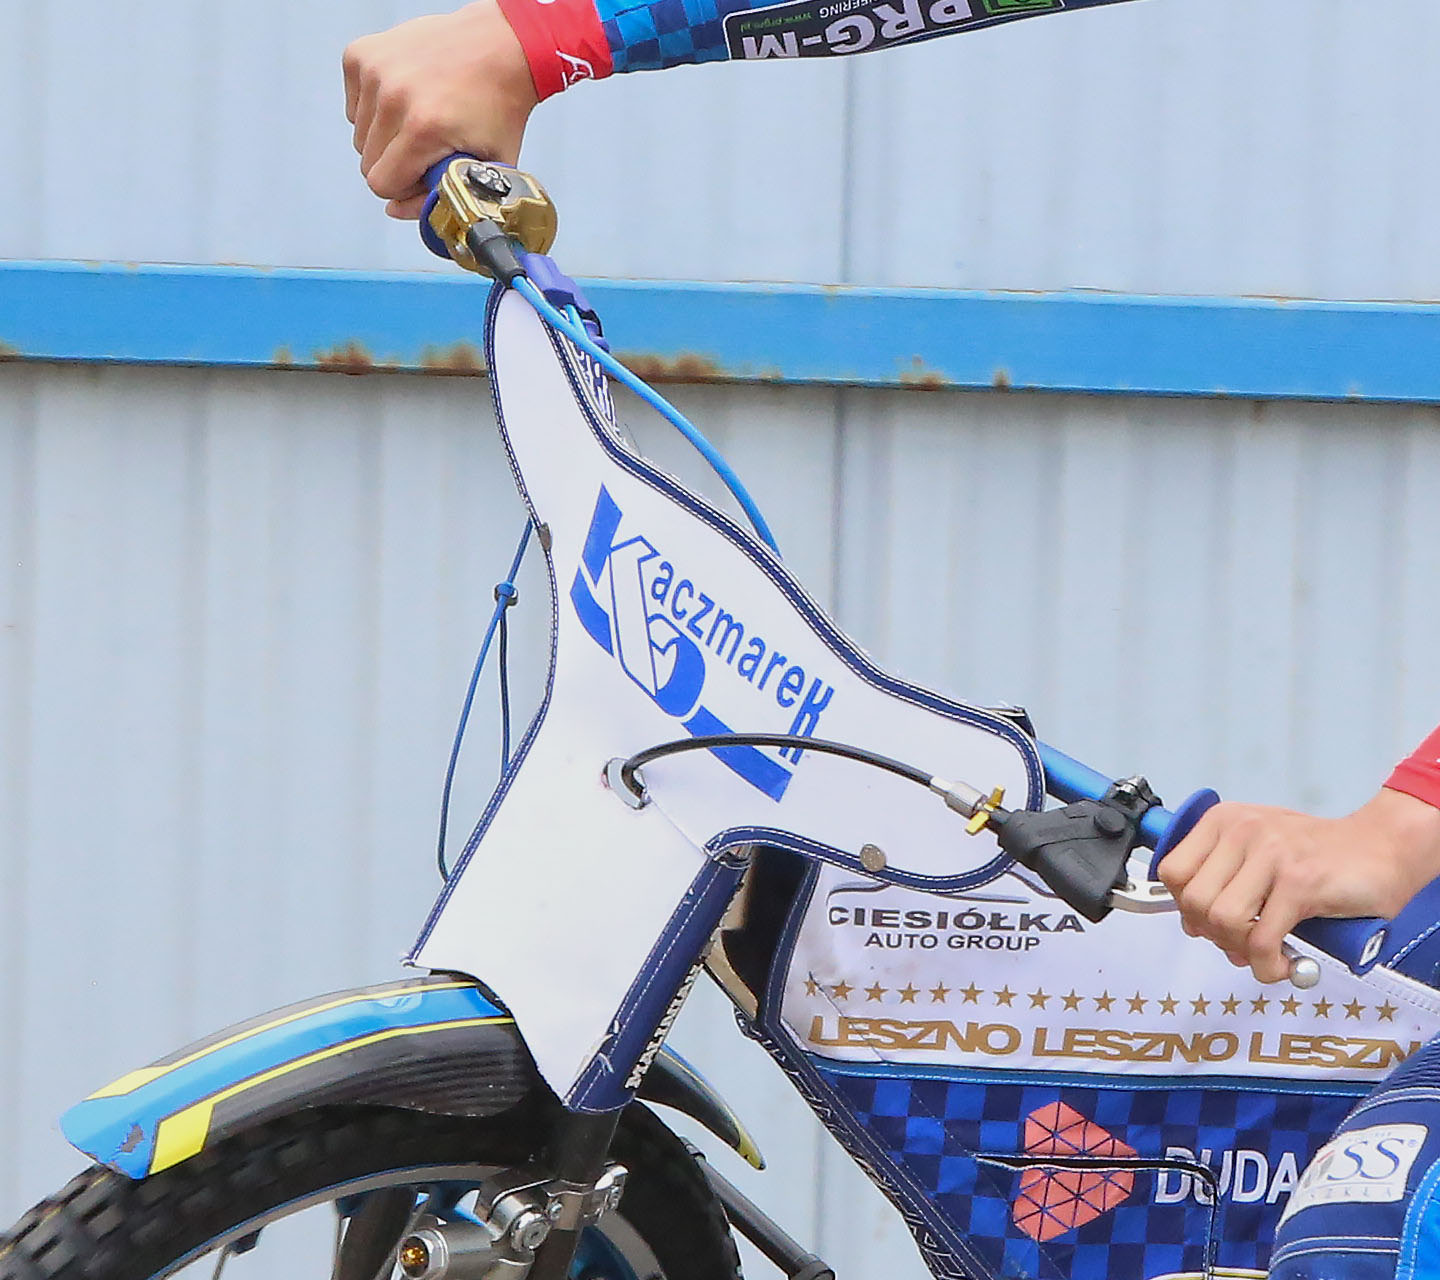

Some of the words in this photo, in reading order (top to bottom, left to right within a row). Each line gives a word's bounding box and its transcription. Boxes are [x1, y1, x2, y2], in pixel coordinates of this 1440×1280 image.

[829, 906, 1086, 934] CIESIÓŁKA
[864, 933, 942, 950] AUTO
[948, 934, 1042, 952] GROUP
[808, 1016, 1021, 1058] LESZNO
[1031, 1027, 1240, 1065] LESZNO
